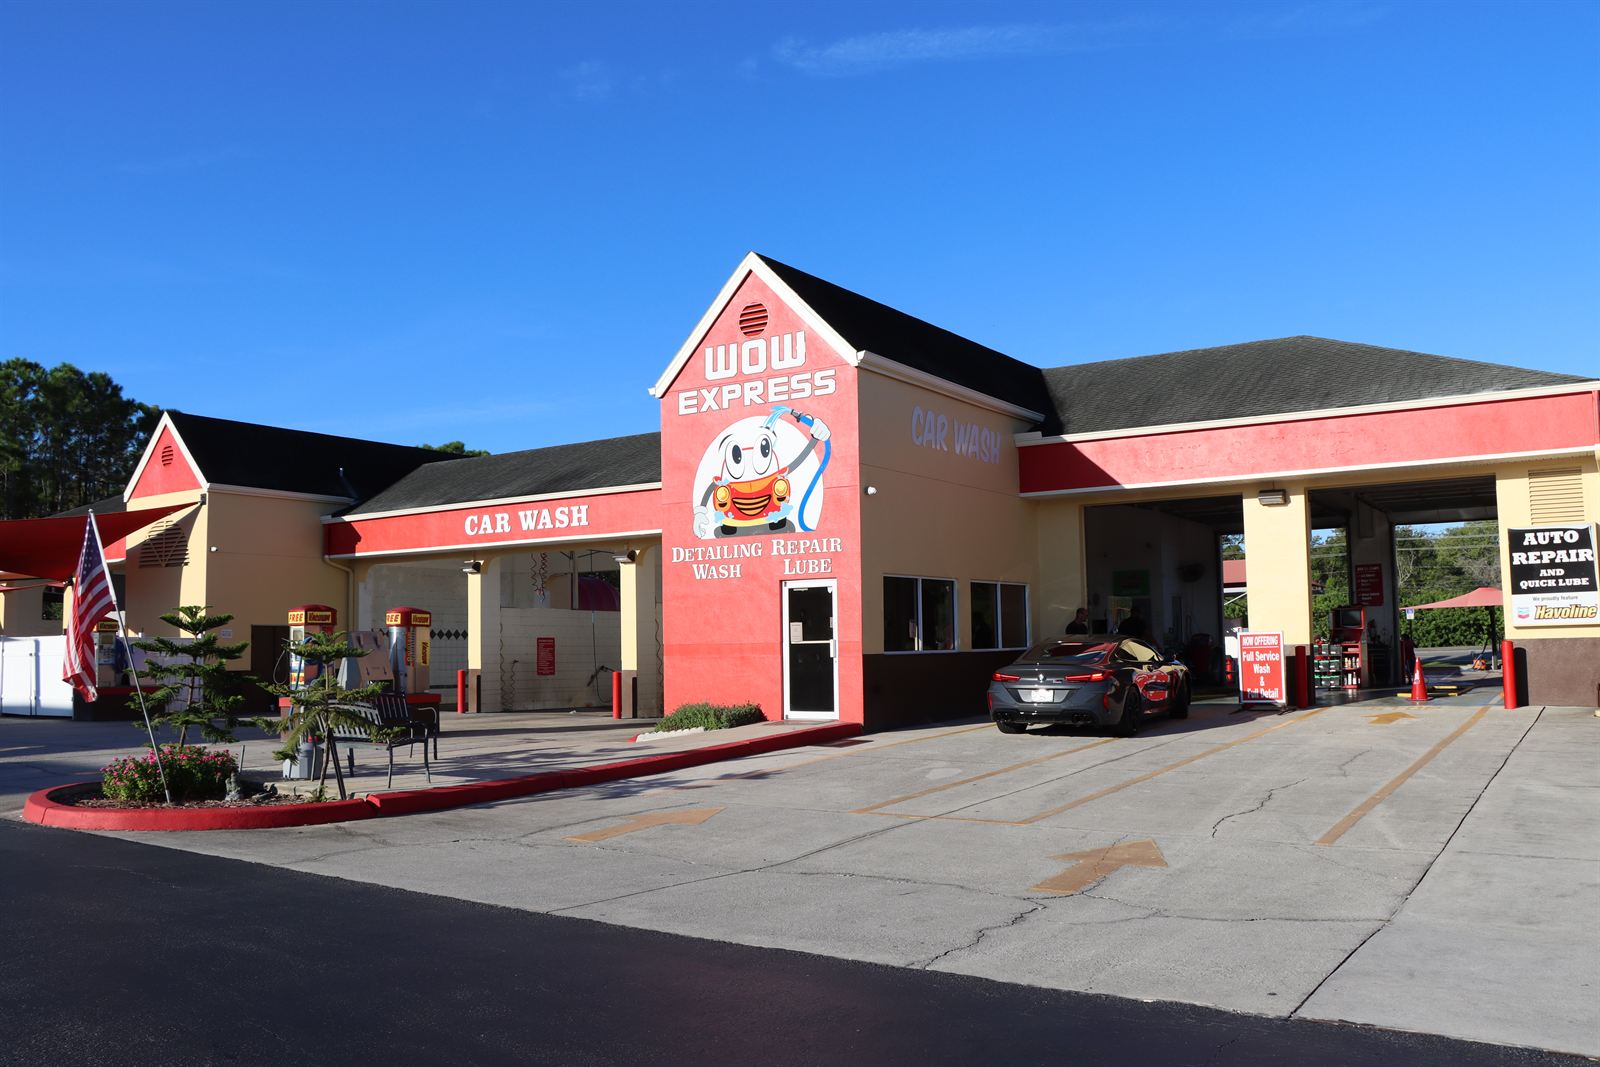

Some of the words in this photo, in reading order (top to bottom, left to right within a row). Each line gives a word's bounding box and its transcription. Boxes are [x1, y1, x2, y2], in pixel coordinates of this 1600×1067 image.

[705, 331, 806, 381] WOW
[678, 369, 836, 416] EXPRESS
[911, 405, 948, 453] CAR
[953, 416, 1001, 464] WASH
[464, 513, 511, 536] CAR
[518, 505, 589, 531] WASH
[1523, 530, 1579, 546] AUTO
[672, 543, 763, 563] DETAILING
[771, 537, 842, 556] REPAIR
[1512, 548, 1594, 566] REPAIR
[692, 564, 742, 580] WASH
[783, 558, 832, 575] LUBE
[1539, 568, 1565, 577] AND
[1520, 579, 1556, 589] QUICK
[1558, 578, 1589, 587] LUBE
[289, 613, 304, 622] FREE
[1535, 604, 1598, 620] Havoline
[1242, 637, 1254, 646] NOW
[1254, 636, 1278, 645] OFFERING
[1242, 651, 1254, 662] Full
[1255, 650, 1279, 661] Service
[1253, 664, 1270, 674] Wash
[1260, 676, 1265, 686] &
[1247, 688, 1259, 698] Full
[1260, 688, 1279, 698] Detail
